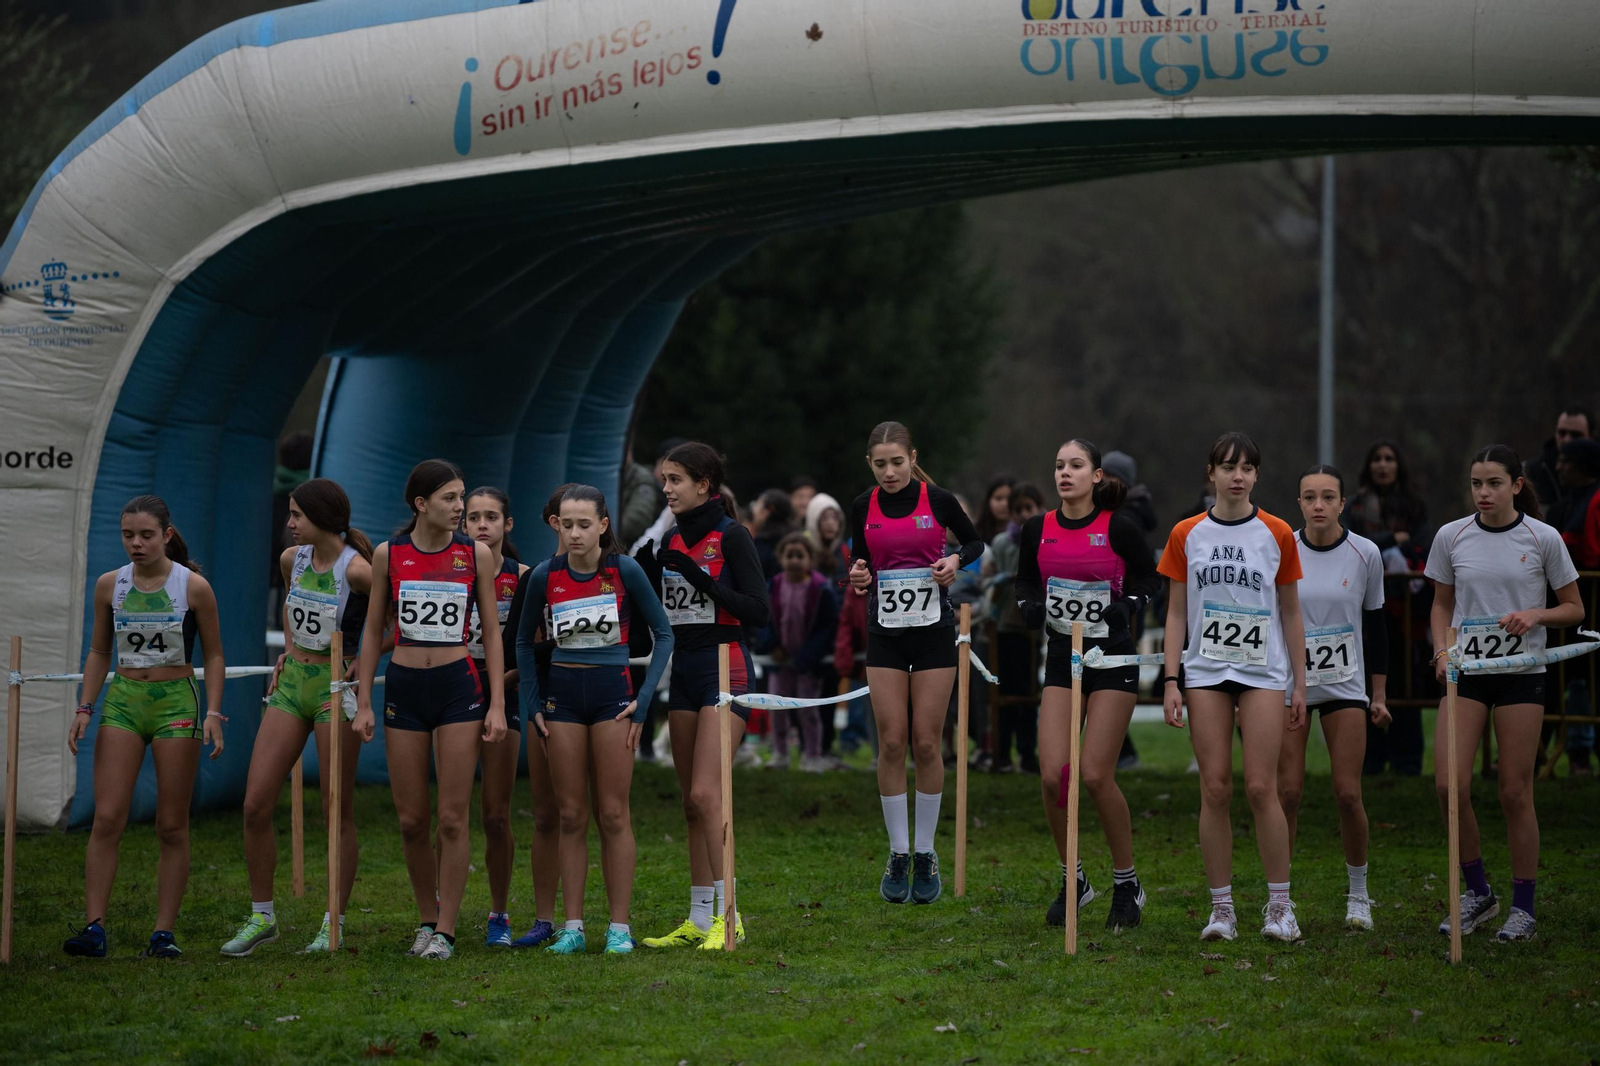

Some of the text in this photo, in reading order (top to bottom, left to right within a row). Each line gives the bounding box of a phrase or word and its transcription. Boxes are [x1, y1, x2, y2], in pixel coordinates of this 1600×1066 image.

[1023, 21, 1108, 36] DESTINO
[1241, 12, 1327, 30] TERMAL
[482, 46, 702, 136] sin ir más lejos
[0, 446, 73, 469] orde
[1210, 546, 1246, 562] ANA
[1196, 565, 1263, 593] MOGAS
[665, 586, 708, 610] 524
[882, 588, 933, 613] 397
[1048, 595, 1104, 623] 398
[293, 607, 321, 635] 95
[401, 600, 459, 627] 528
[557, 614, 613, 640] 526
[1203, 621, 1263, 649] 424
[127, 632, 168, 653] 94
[1464, 634, 1524, 659] 422
